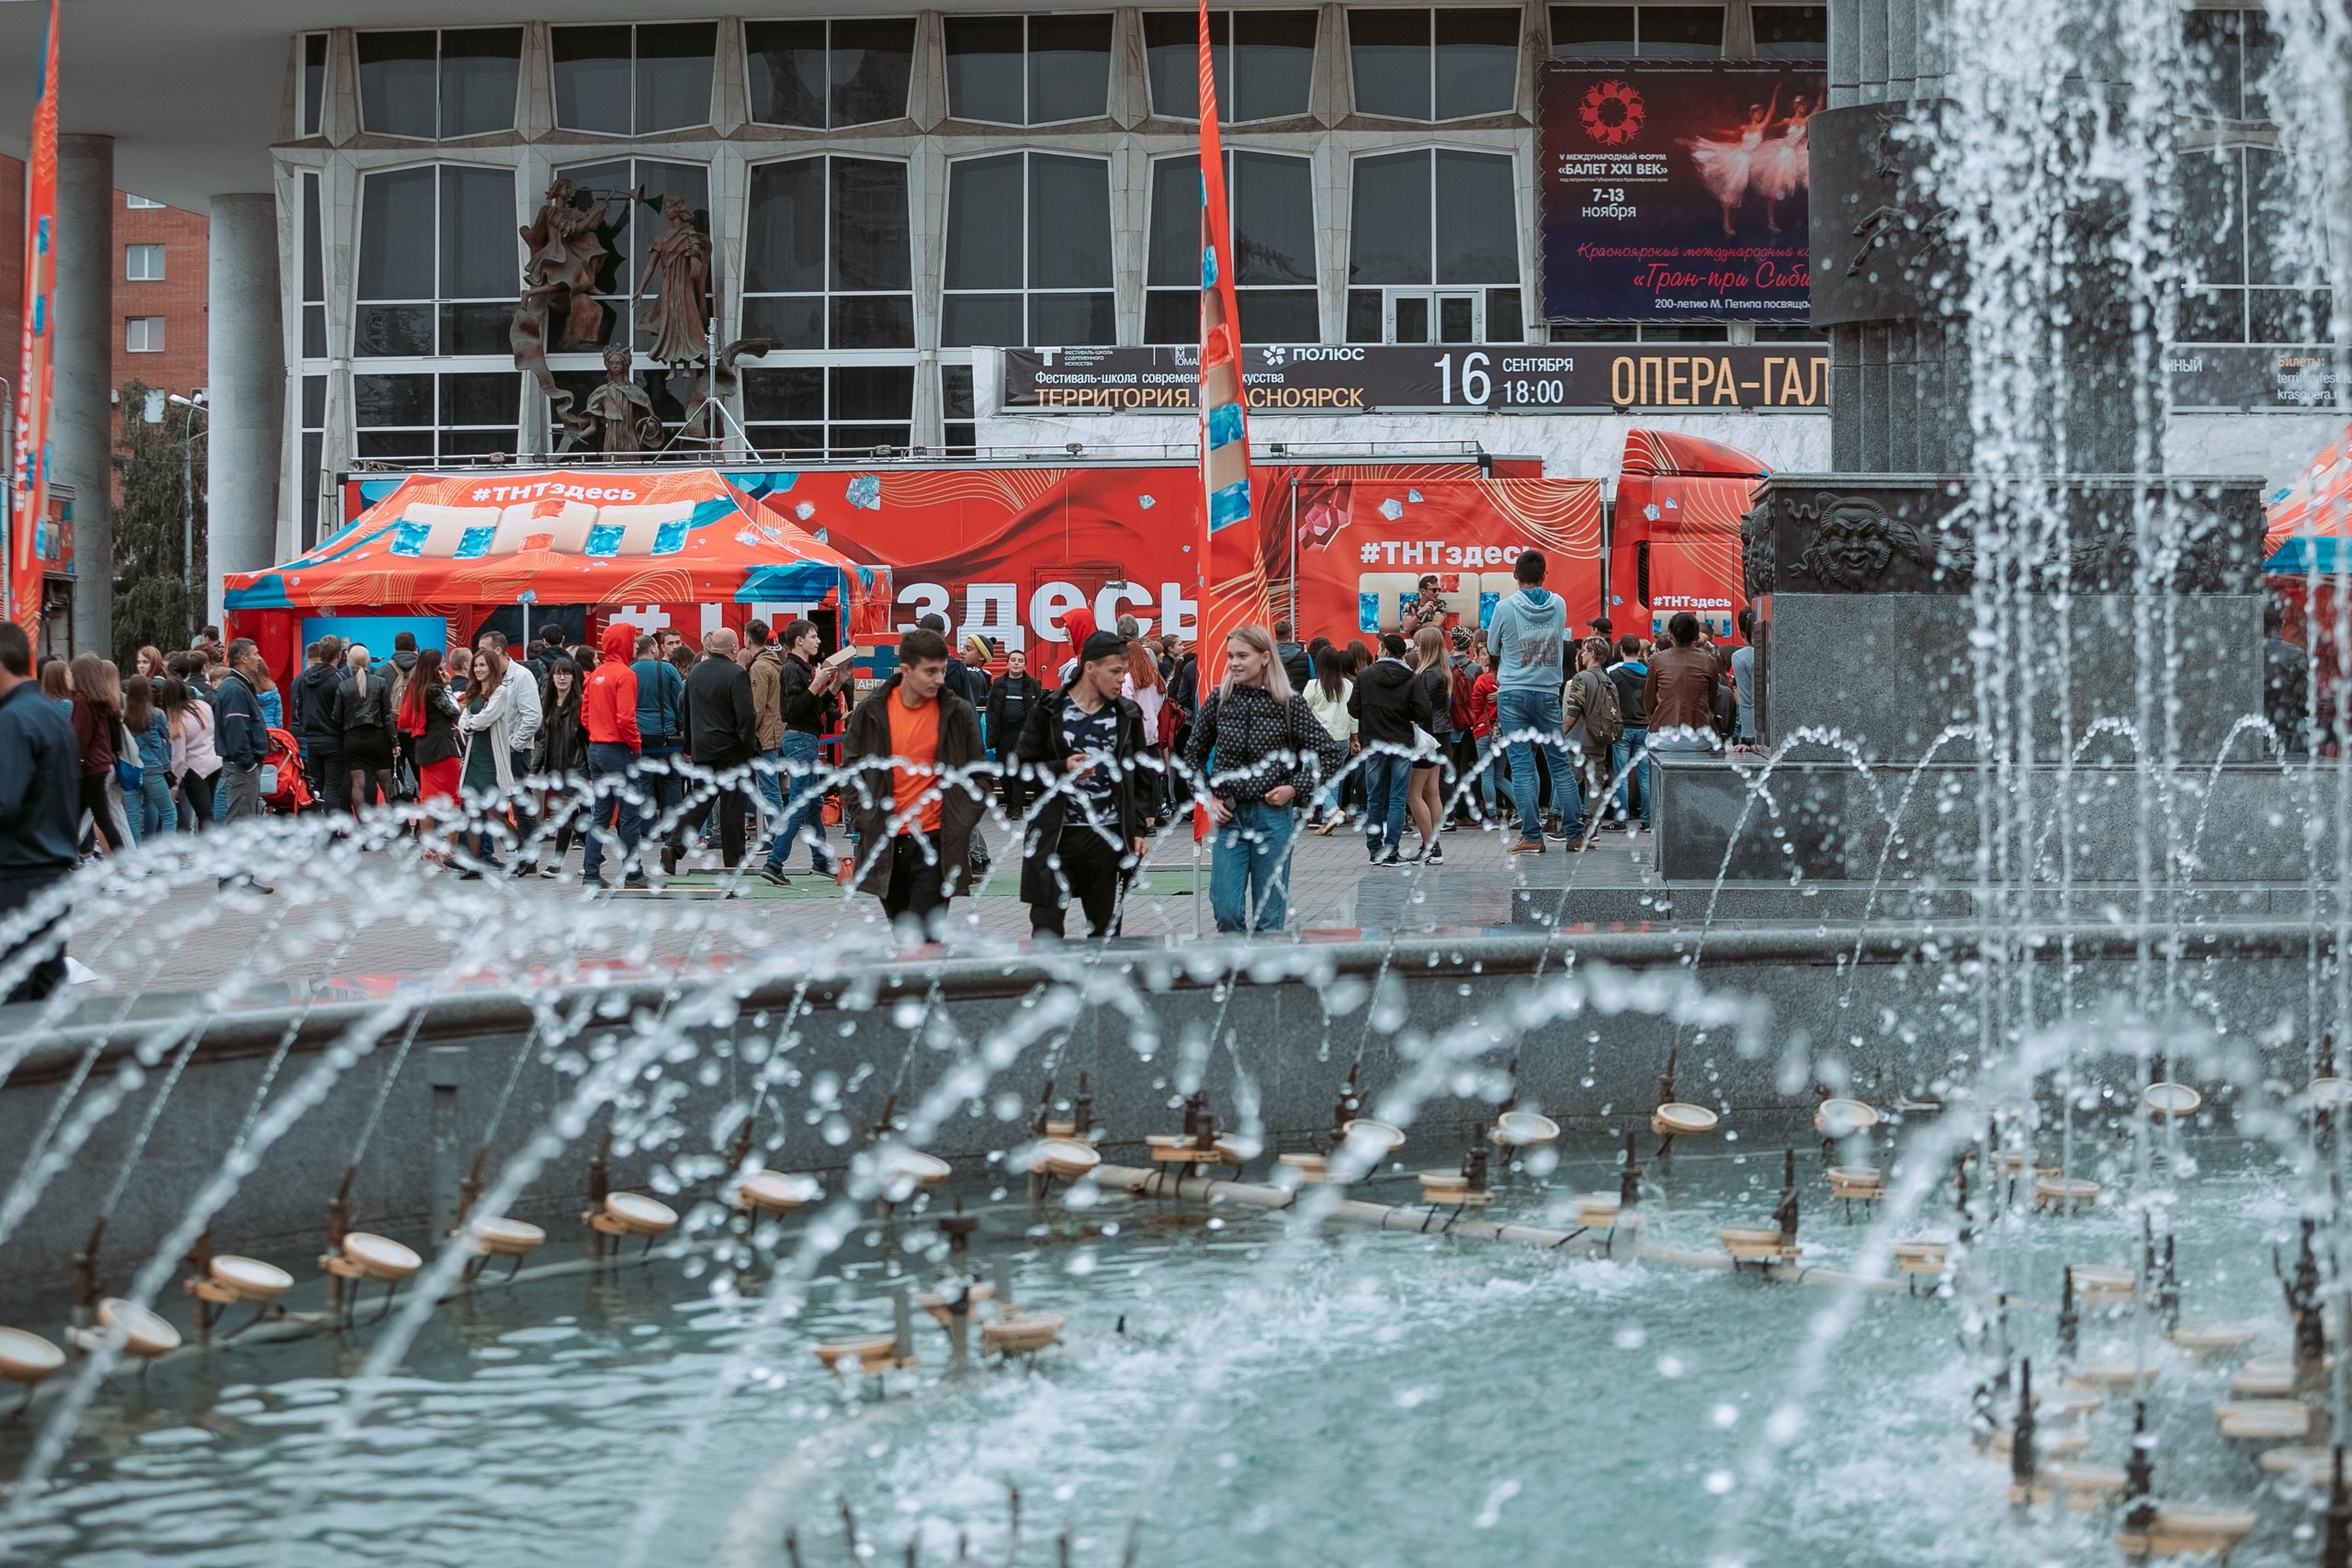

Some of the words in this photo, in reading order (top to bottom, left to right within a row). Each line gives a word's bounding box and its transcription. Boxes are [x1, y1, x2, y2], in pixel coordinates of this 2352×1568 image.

[1566, 152, 1637, 161] МЕЖДУНАРОДНЫЙ
[1558, 164, 1608, 175] «БАЛЕТ
[1611, 164, 1632, 175] XXI
[1636, 164, 1668, 175] ВЕК»
[1592, 188, 1624, 202] 7-13
[1582, 203, 1636, 220] ноября
[1577, 243, 1679, 261] Красноярский
[1683, 245, 1793, 262] международный
[1756, 261, 1810, 288] Сиби
[1655, 299, 1709, 309] 200-летию
[1710, 299, 1723, 309] М.
[1724, 299, 1762, 309] Петипа
[1764, 300, 1810, 310] посвяща
[1293, 348, 1365, 361] ПОЛЮС
[1502, 357, 1574, 372] СЕНТЯБРЯ
[1035, 371, 1137, 384] Фестиваль-школа
[1142, 373, 1200, 386] современ
[1242, 373, 1284, 386] кусства
[1434, 352, 1491, 405] 16
[1611, 356, 1828, 406] ОПЕРА-ГАЛ
[1035, 388, 1196, 407] ТЕРРИТОРИЯ.
[1243, 388, 1364, 407] СНОЯРСК
[1503, 379, 1564, 404] 18:00
[471, 481, 637, 502] #ТНТздесь
[389, 500, 696, 560] ТНТ
[1360, 541, 1529, 568] #ТНТздес
[1653, 595, 1732, 608] #ТНТздесь
[1524, 622, 1555, 631] adidas
